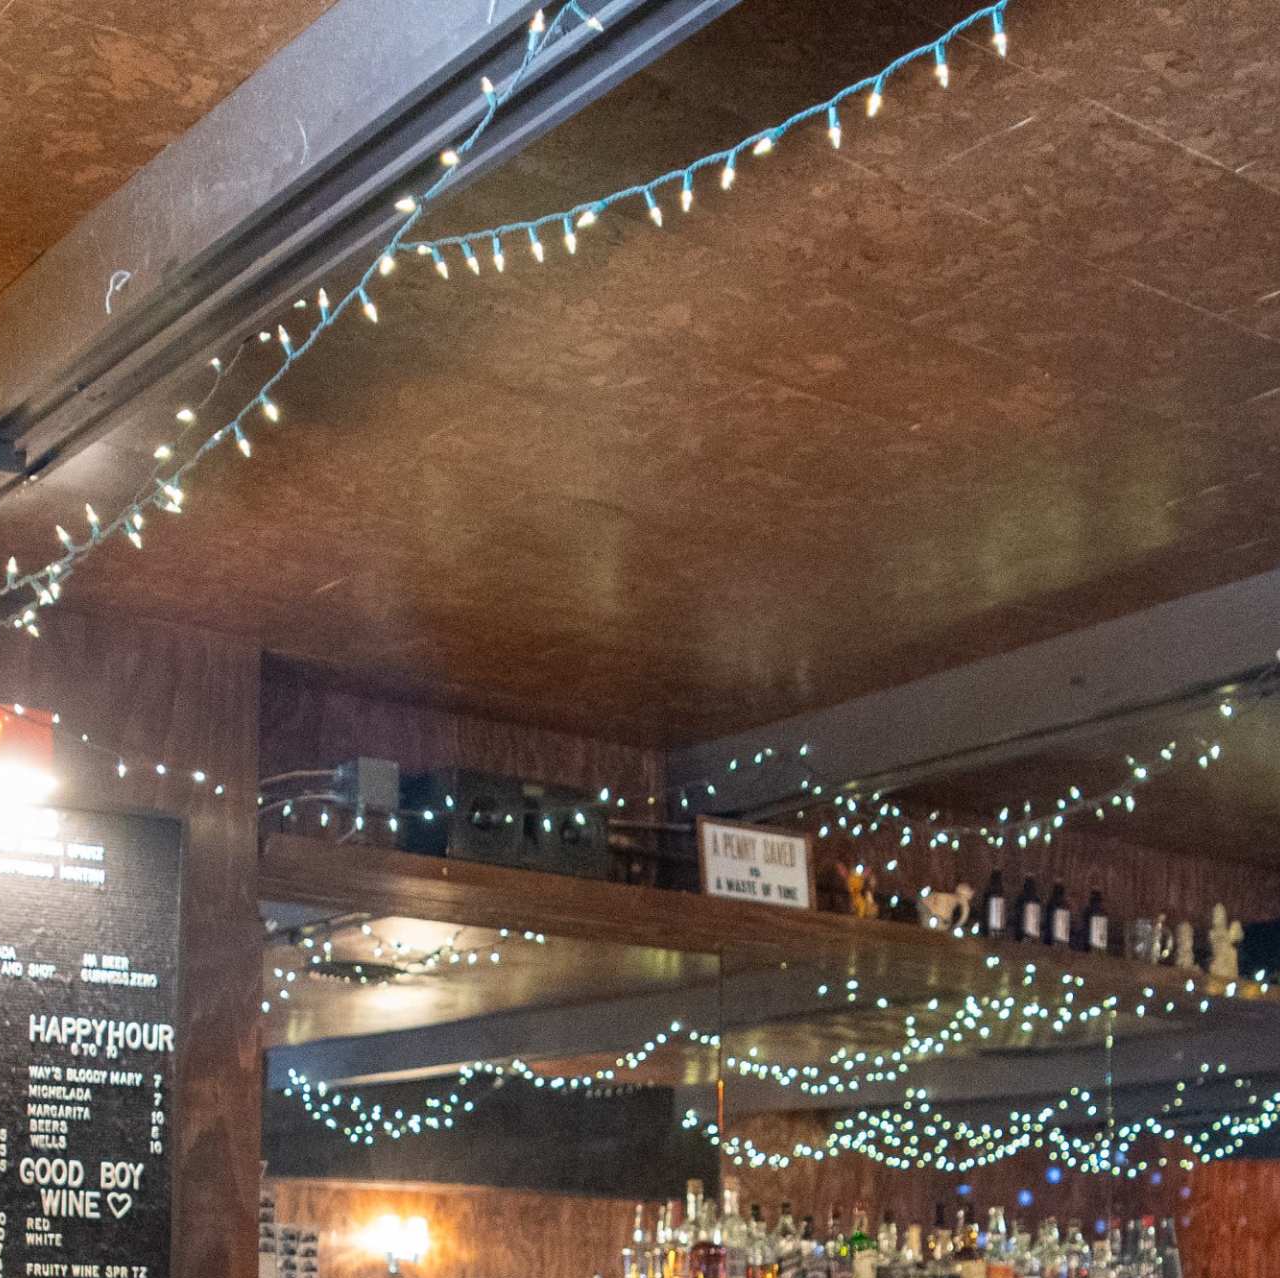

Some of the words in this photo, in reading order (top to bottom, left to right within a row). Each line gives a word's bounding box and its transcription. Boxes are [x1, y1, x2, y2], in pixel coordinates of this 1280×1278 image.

[1, 961, 24, 977] AND
[27, 963, 57, 979] SHOT
[81, 1043, 97, 1058] TO
[66, 1067, 108, 1084] BLOODY
[110, 1071, 143, 1087] MARY
[153, 1073, 162, 1088] 7
[153, 1092, 162, 1107] 7
[27, 1103, 91, 1121] MARGARITA
[151, 1110, 165, 1125] 10
[29, 1118, 68, 1134] BEERS
[29, 1134, 68, 1150] WELLS
[149, 1140, 162, 1155] 10
[19, 1156, 85, 1189] GOOD
[99, 1160, 145, 1191] BOY
[39, 1187, 102, 1219] WINE
[25, 1216, 51, 1232] RED
[25, 1232, 63, 1248] WHITE
[26, 1262, 69, 1278] FRUITY
[71, 1264, 101, 1278] WINE
